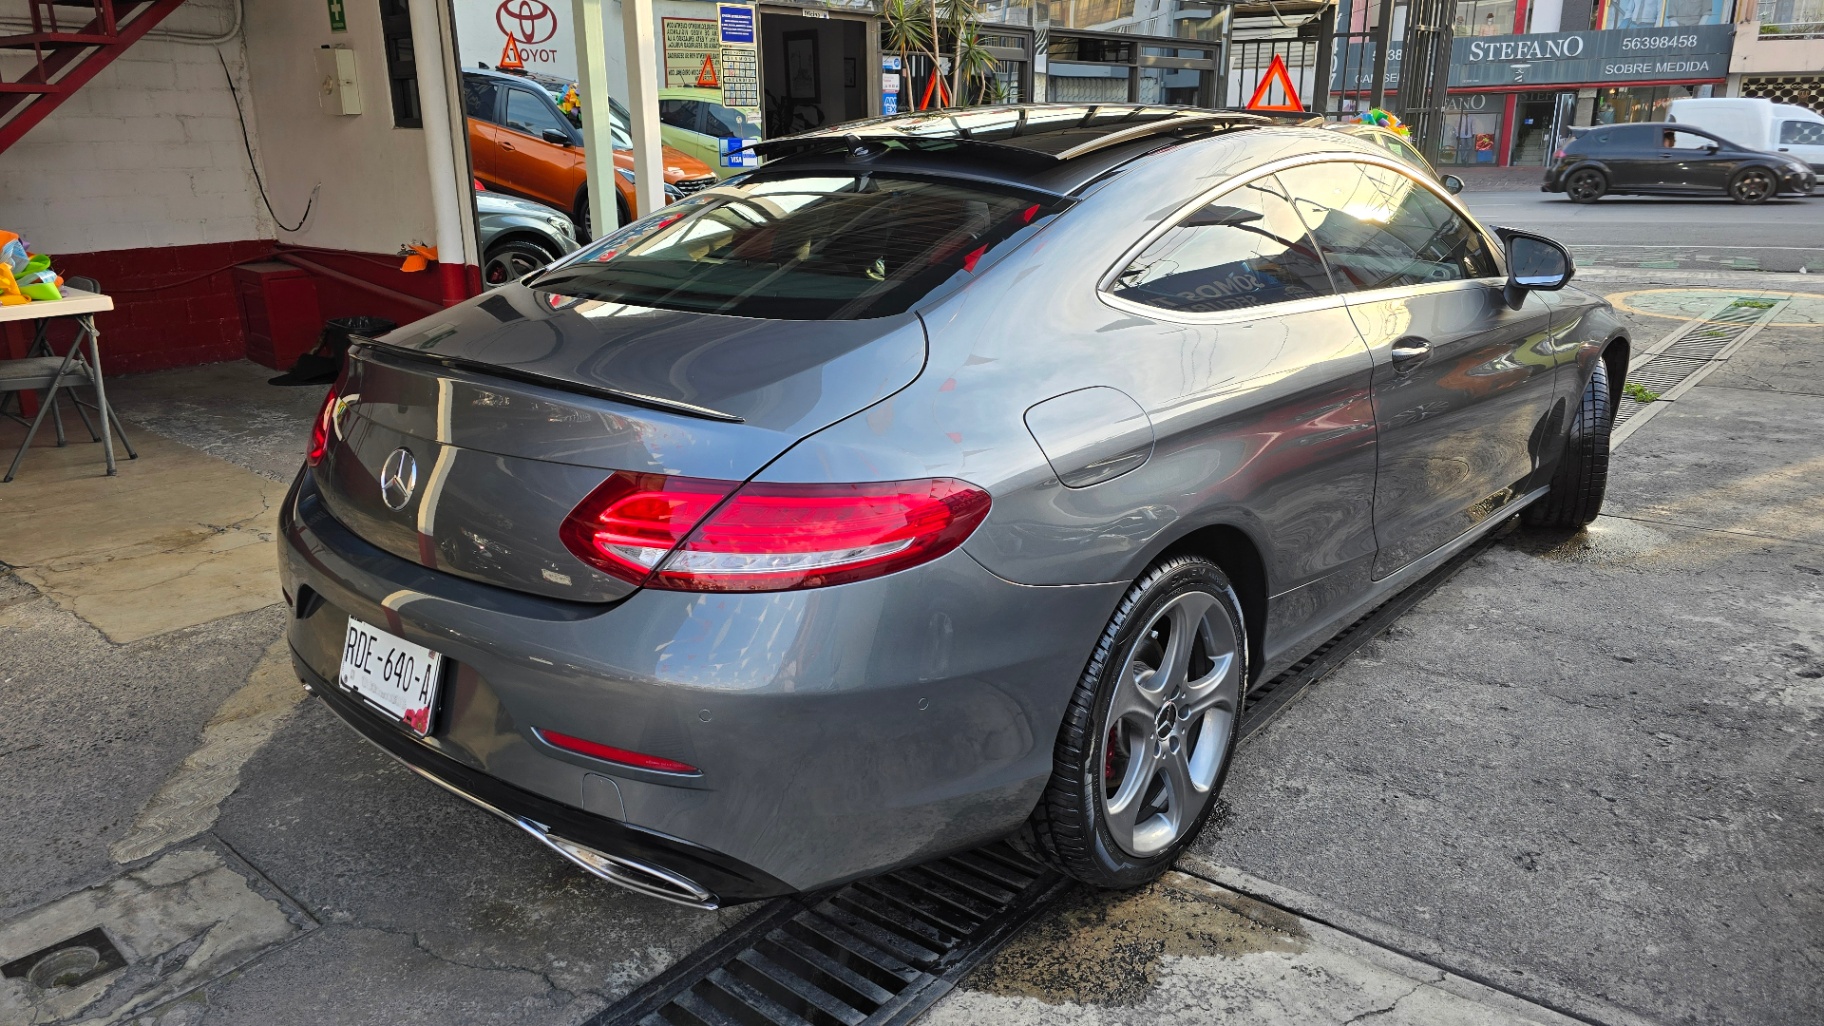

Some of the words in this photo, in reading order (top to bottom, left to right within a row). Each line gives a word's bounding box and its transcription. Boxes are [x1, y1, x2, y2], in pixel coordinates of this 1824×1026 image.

[1469, 36, 1584, 62] STEFANO
[1622, 34, 1697, 51] 56398458
[1605, 63, 1652, 75] SOBRE
[1655, 60, 1709, 73] MEDIDA
[344, 627, 432, 705] RDE-640-A
